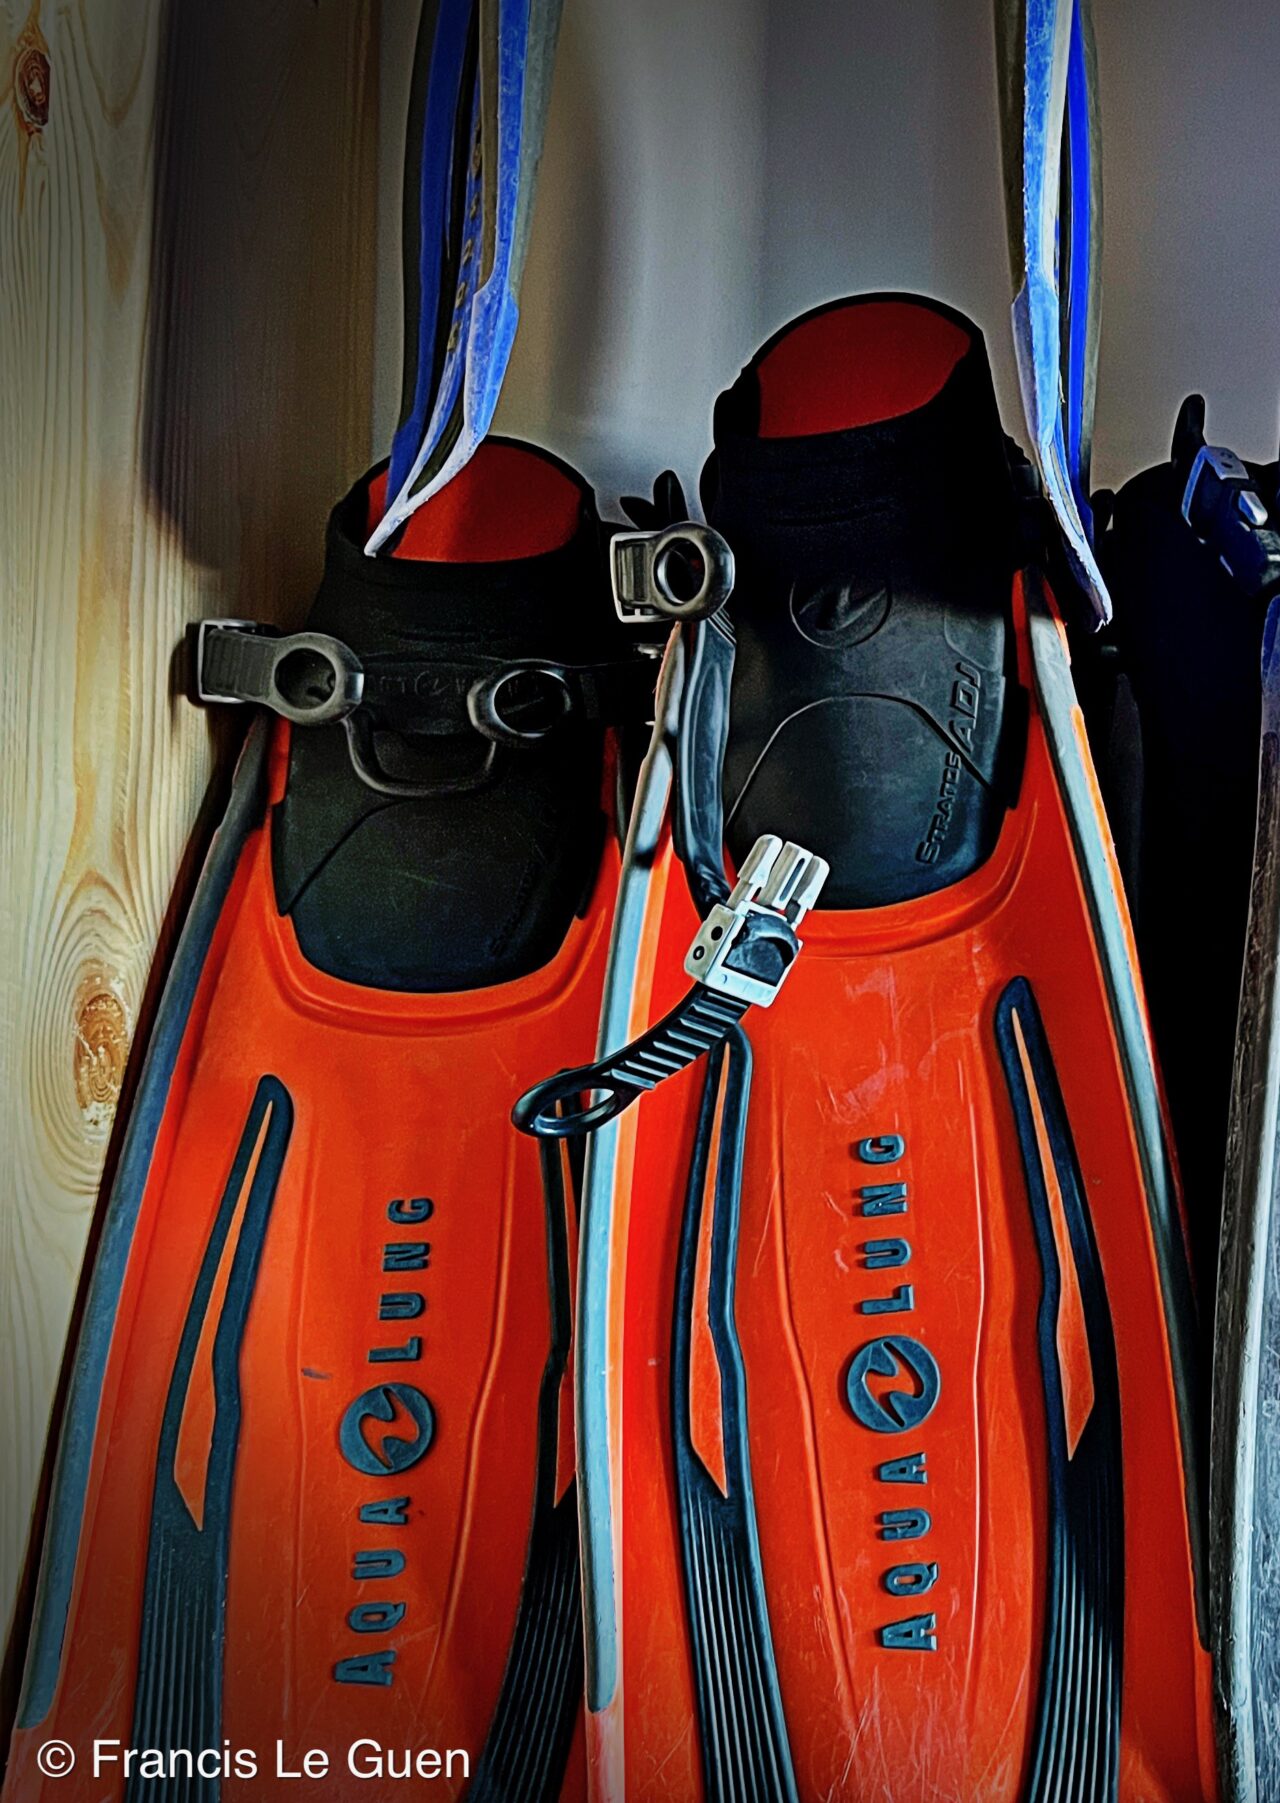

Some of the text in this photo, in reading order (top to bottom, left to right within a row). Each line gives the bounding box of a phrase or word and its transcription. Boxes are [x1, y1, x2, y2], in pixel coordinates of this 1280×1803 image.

[949, 662, 981, 752] ADJ
[334, 1197, 434, 1686] AQUA LUNG
[855, 1134, 937, 1651] AQUA LUNG
